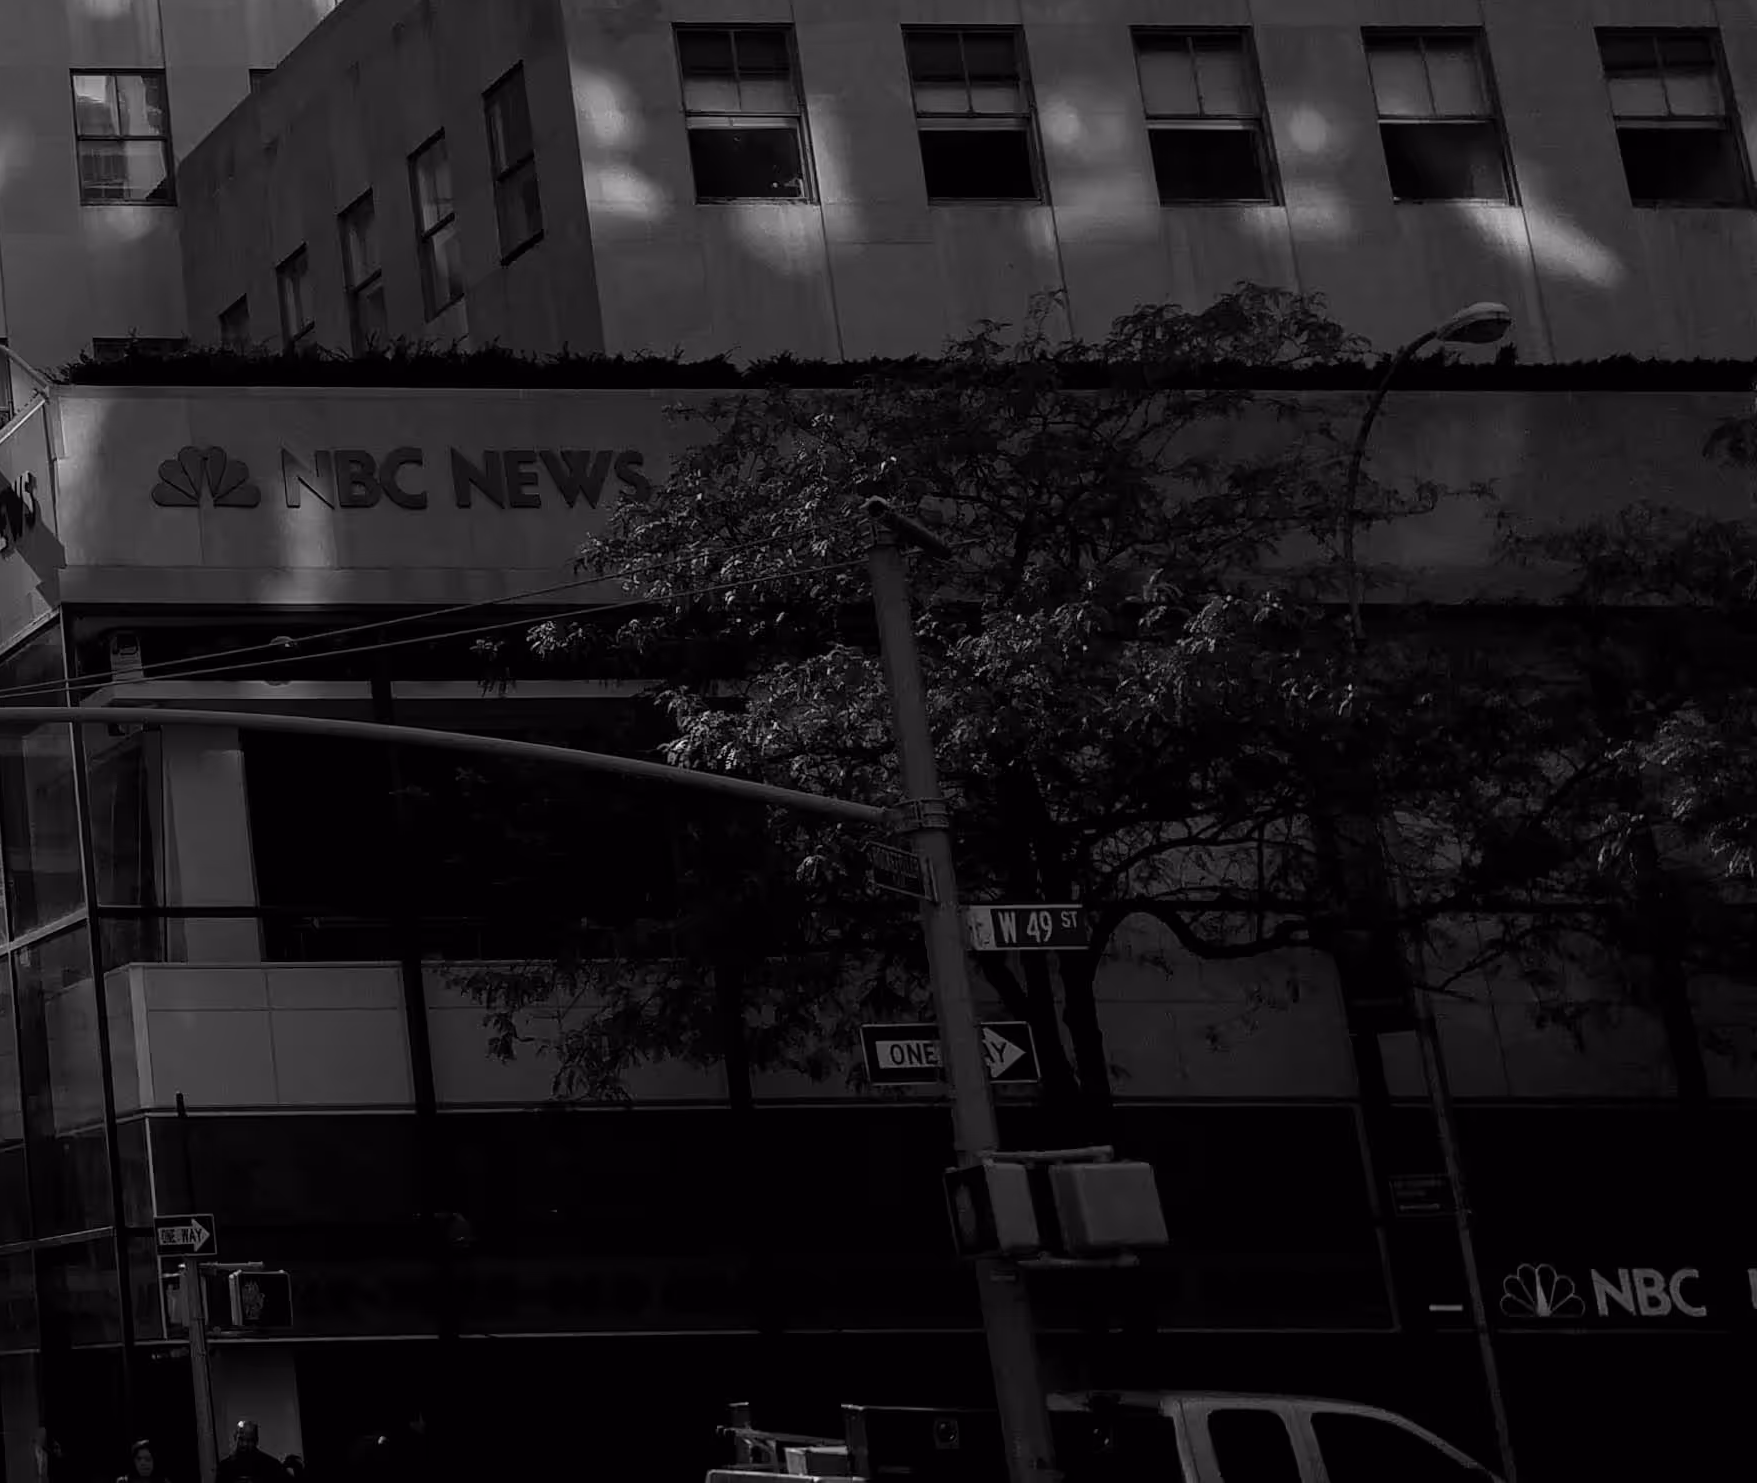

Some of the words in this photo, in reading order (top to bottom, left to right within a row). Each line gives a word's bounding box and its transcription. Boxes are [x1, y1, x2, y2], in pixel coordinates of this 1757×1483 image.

[280, 445, 429, 510] NBC
[447, 444, 653, 510] NEWS
[997, 910, 1017, 944] W
[1026, 910, 1053, 944] 49
[1060, 910, 1078, 929] ST
[890, 1043, 935, 1066] ONE
[983, 1041, 1007, 1064] AY
[181, 1228, 203, 1243] WAY
[1590, 1265, 1707, 1317] NBC
